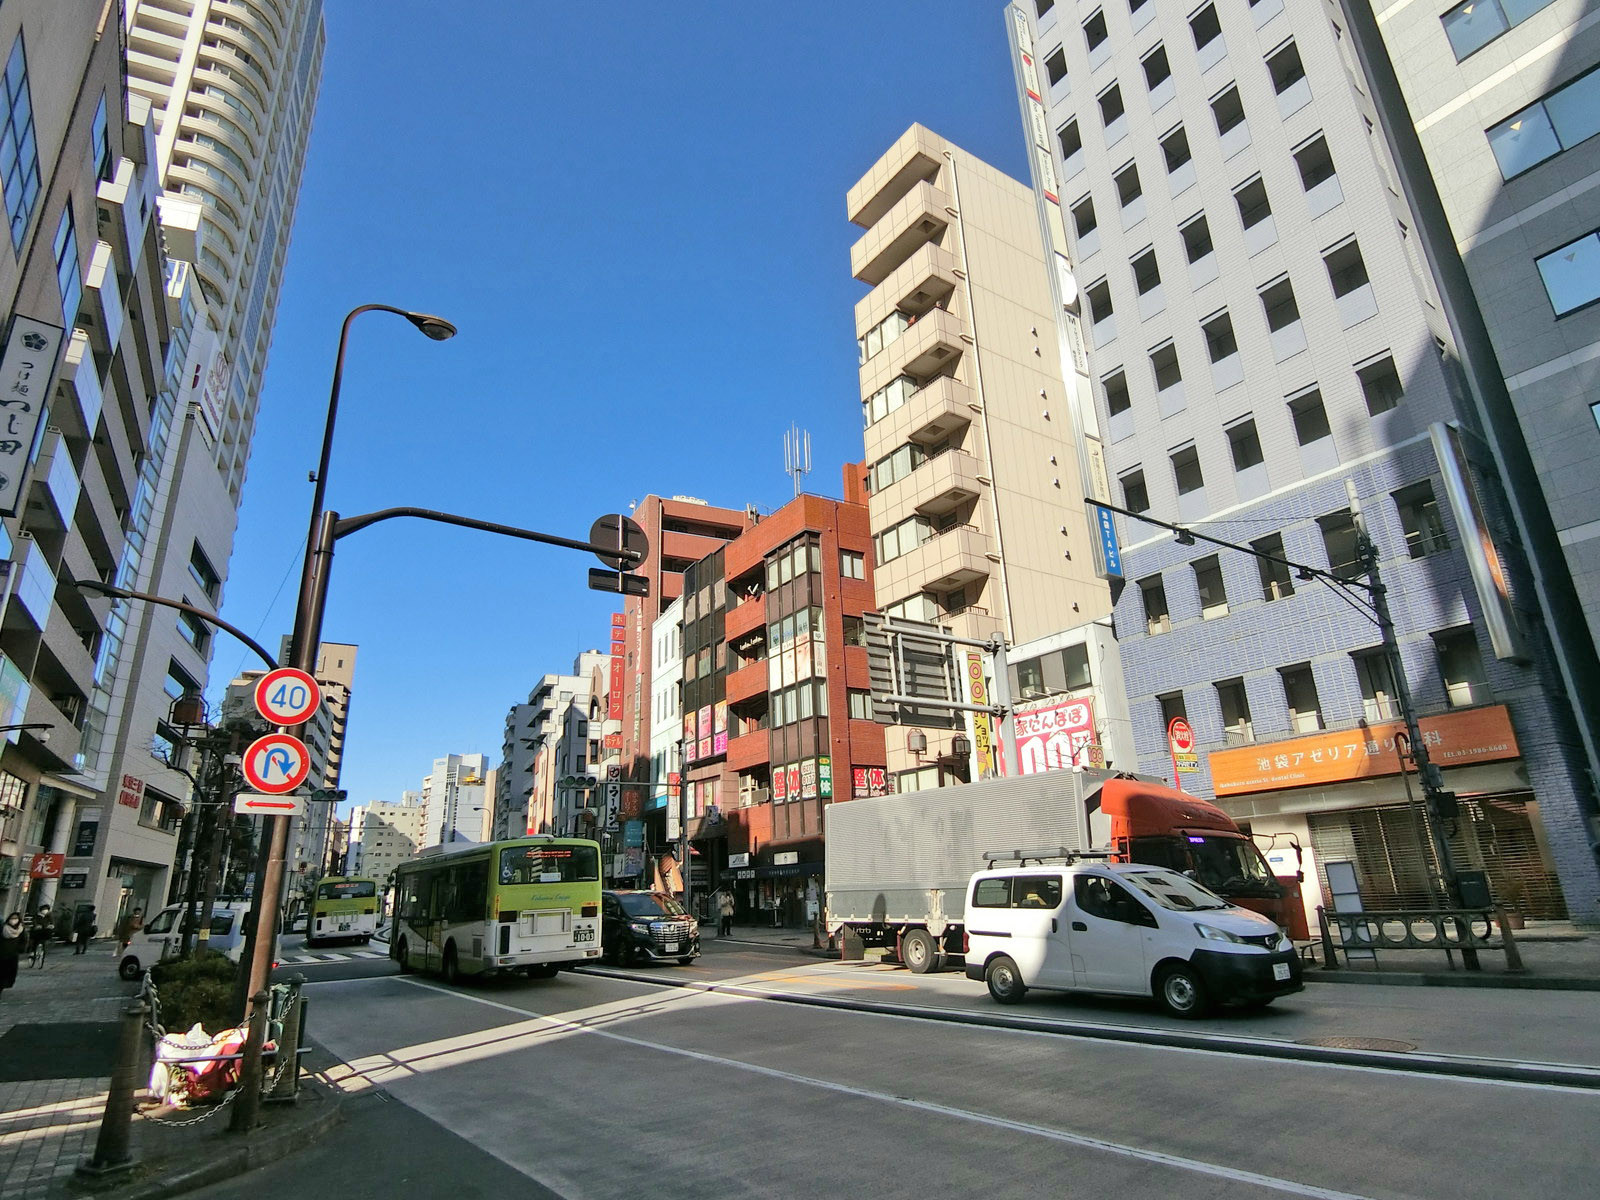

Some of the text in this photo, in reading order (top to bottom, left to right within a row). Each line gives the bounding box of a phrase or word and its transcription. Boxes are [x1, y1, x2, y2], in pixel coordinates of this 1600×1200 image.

[271, 683, 306, 709] 40
[605, 736, 621, 747] ホテル
[854, 768, 885, 788] 整体
[608, 786, 619, 827] ラーメン
